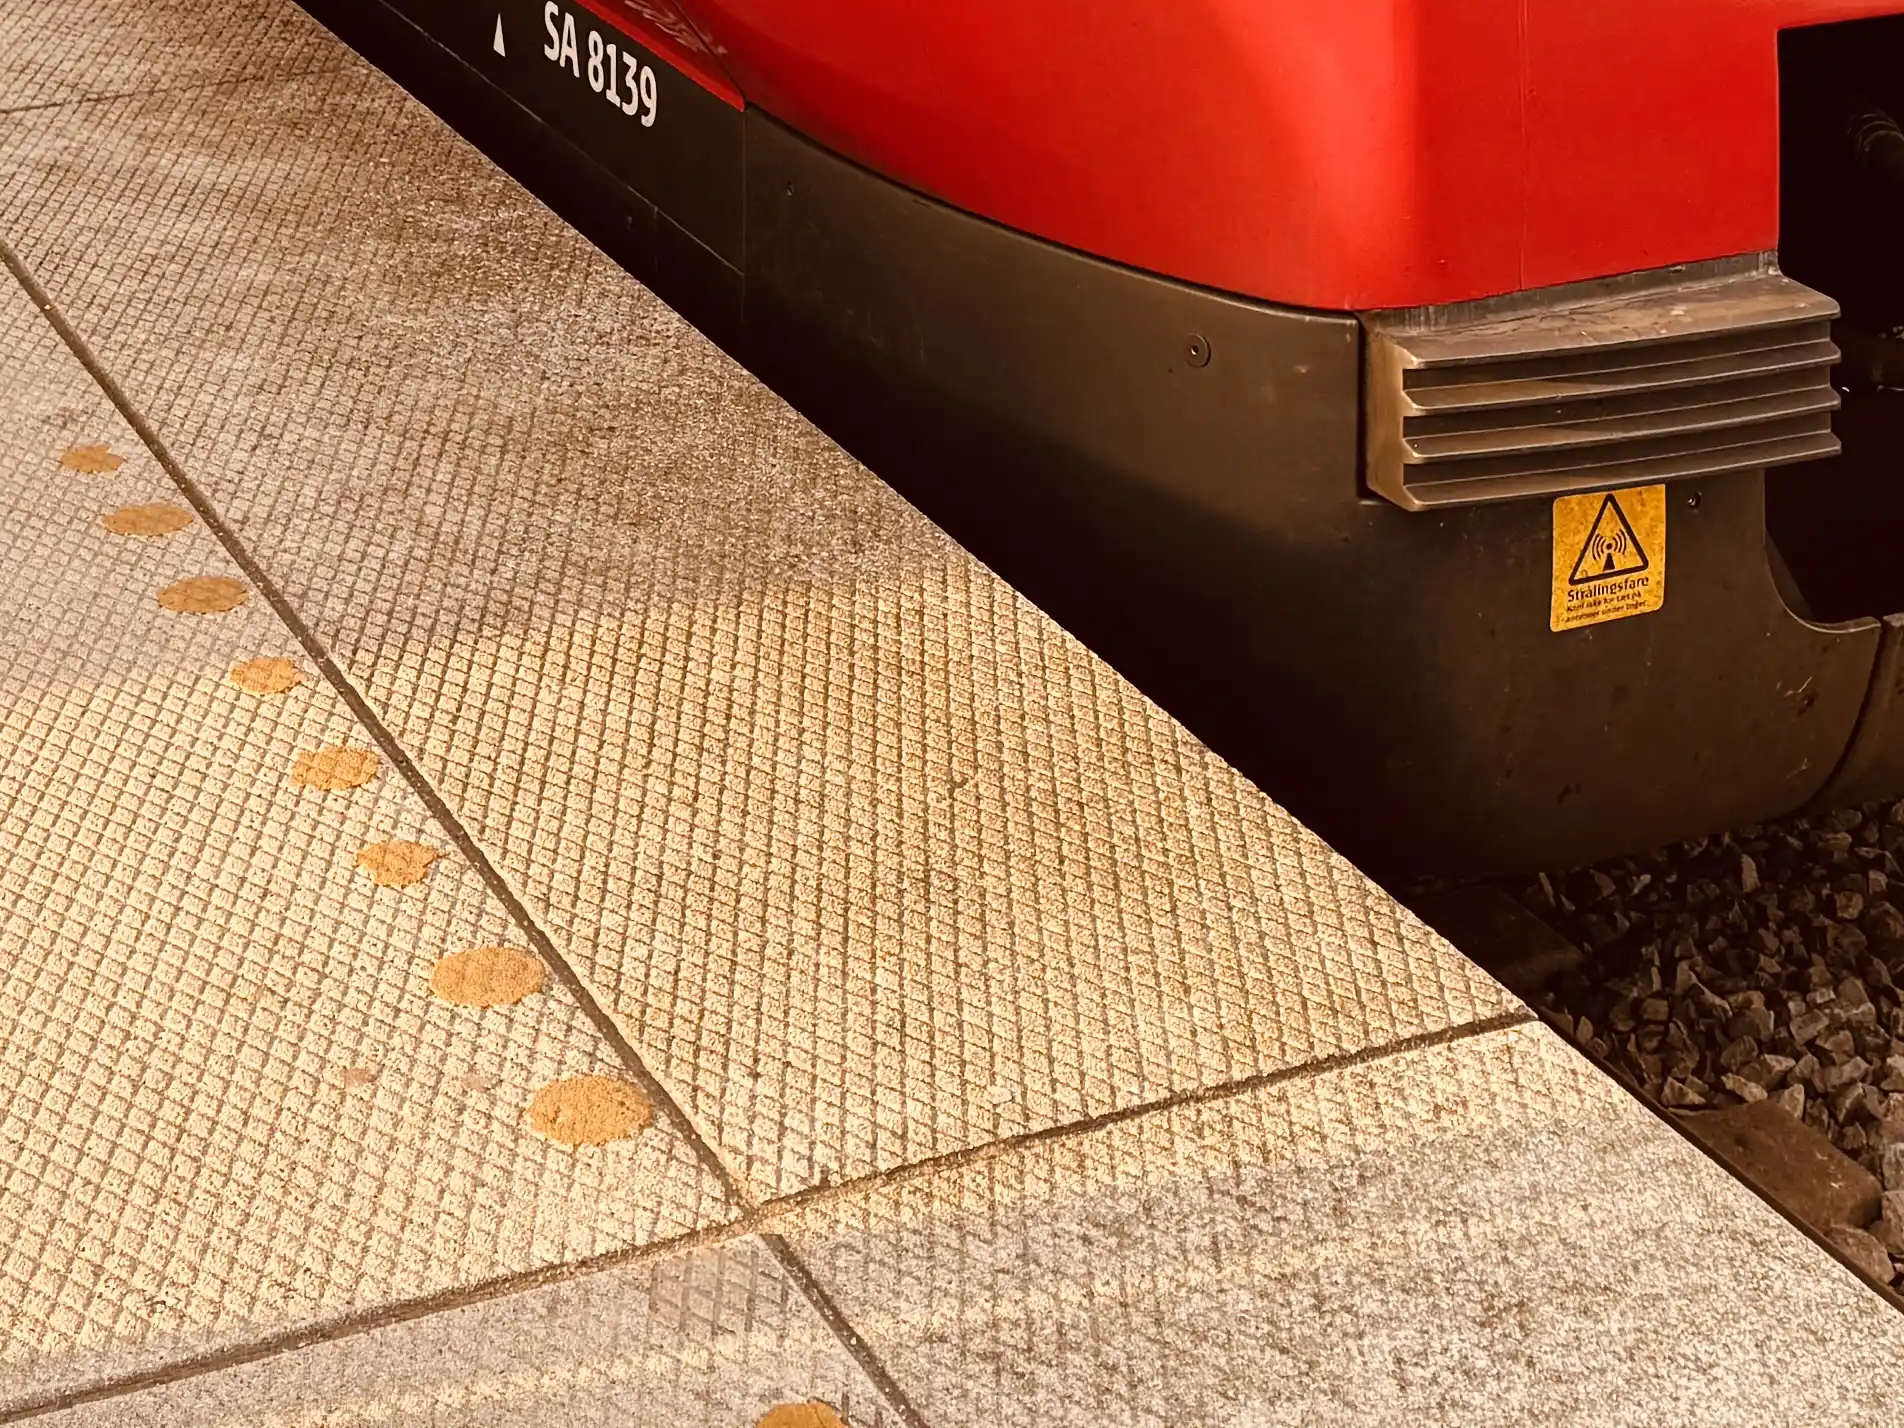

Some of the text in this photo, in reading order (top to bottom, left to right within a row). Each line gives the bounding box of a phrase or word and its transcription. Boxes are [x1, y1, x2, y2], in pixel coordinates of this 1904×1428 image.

[544, 0, 657, 127] SA 8139
[1567, 576, 1649, 602] Strålingsfare
